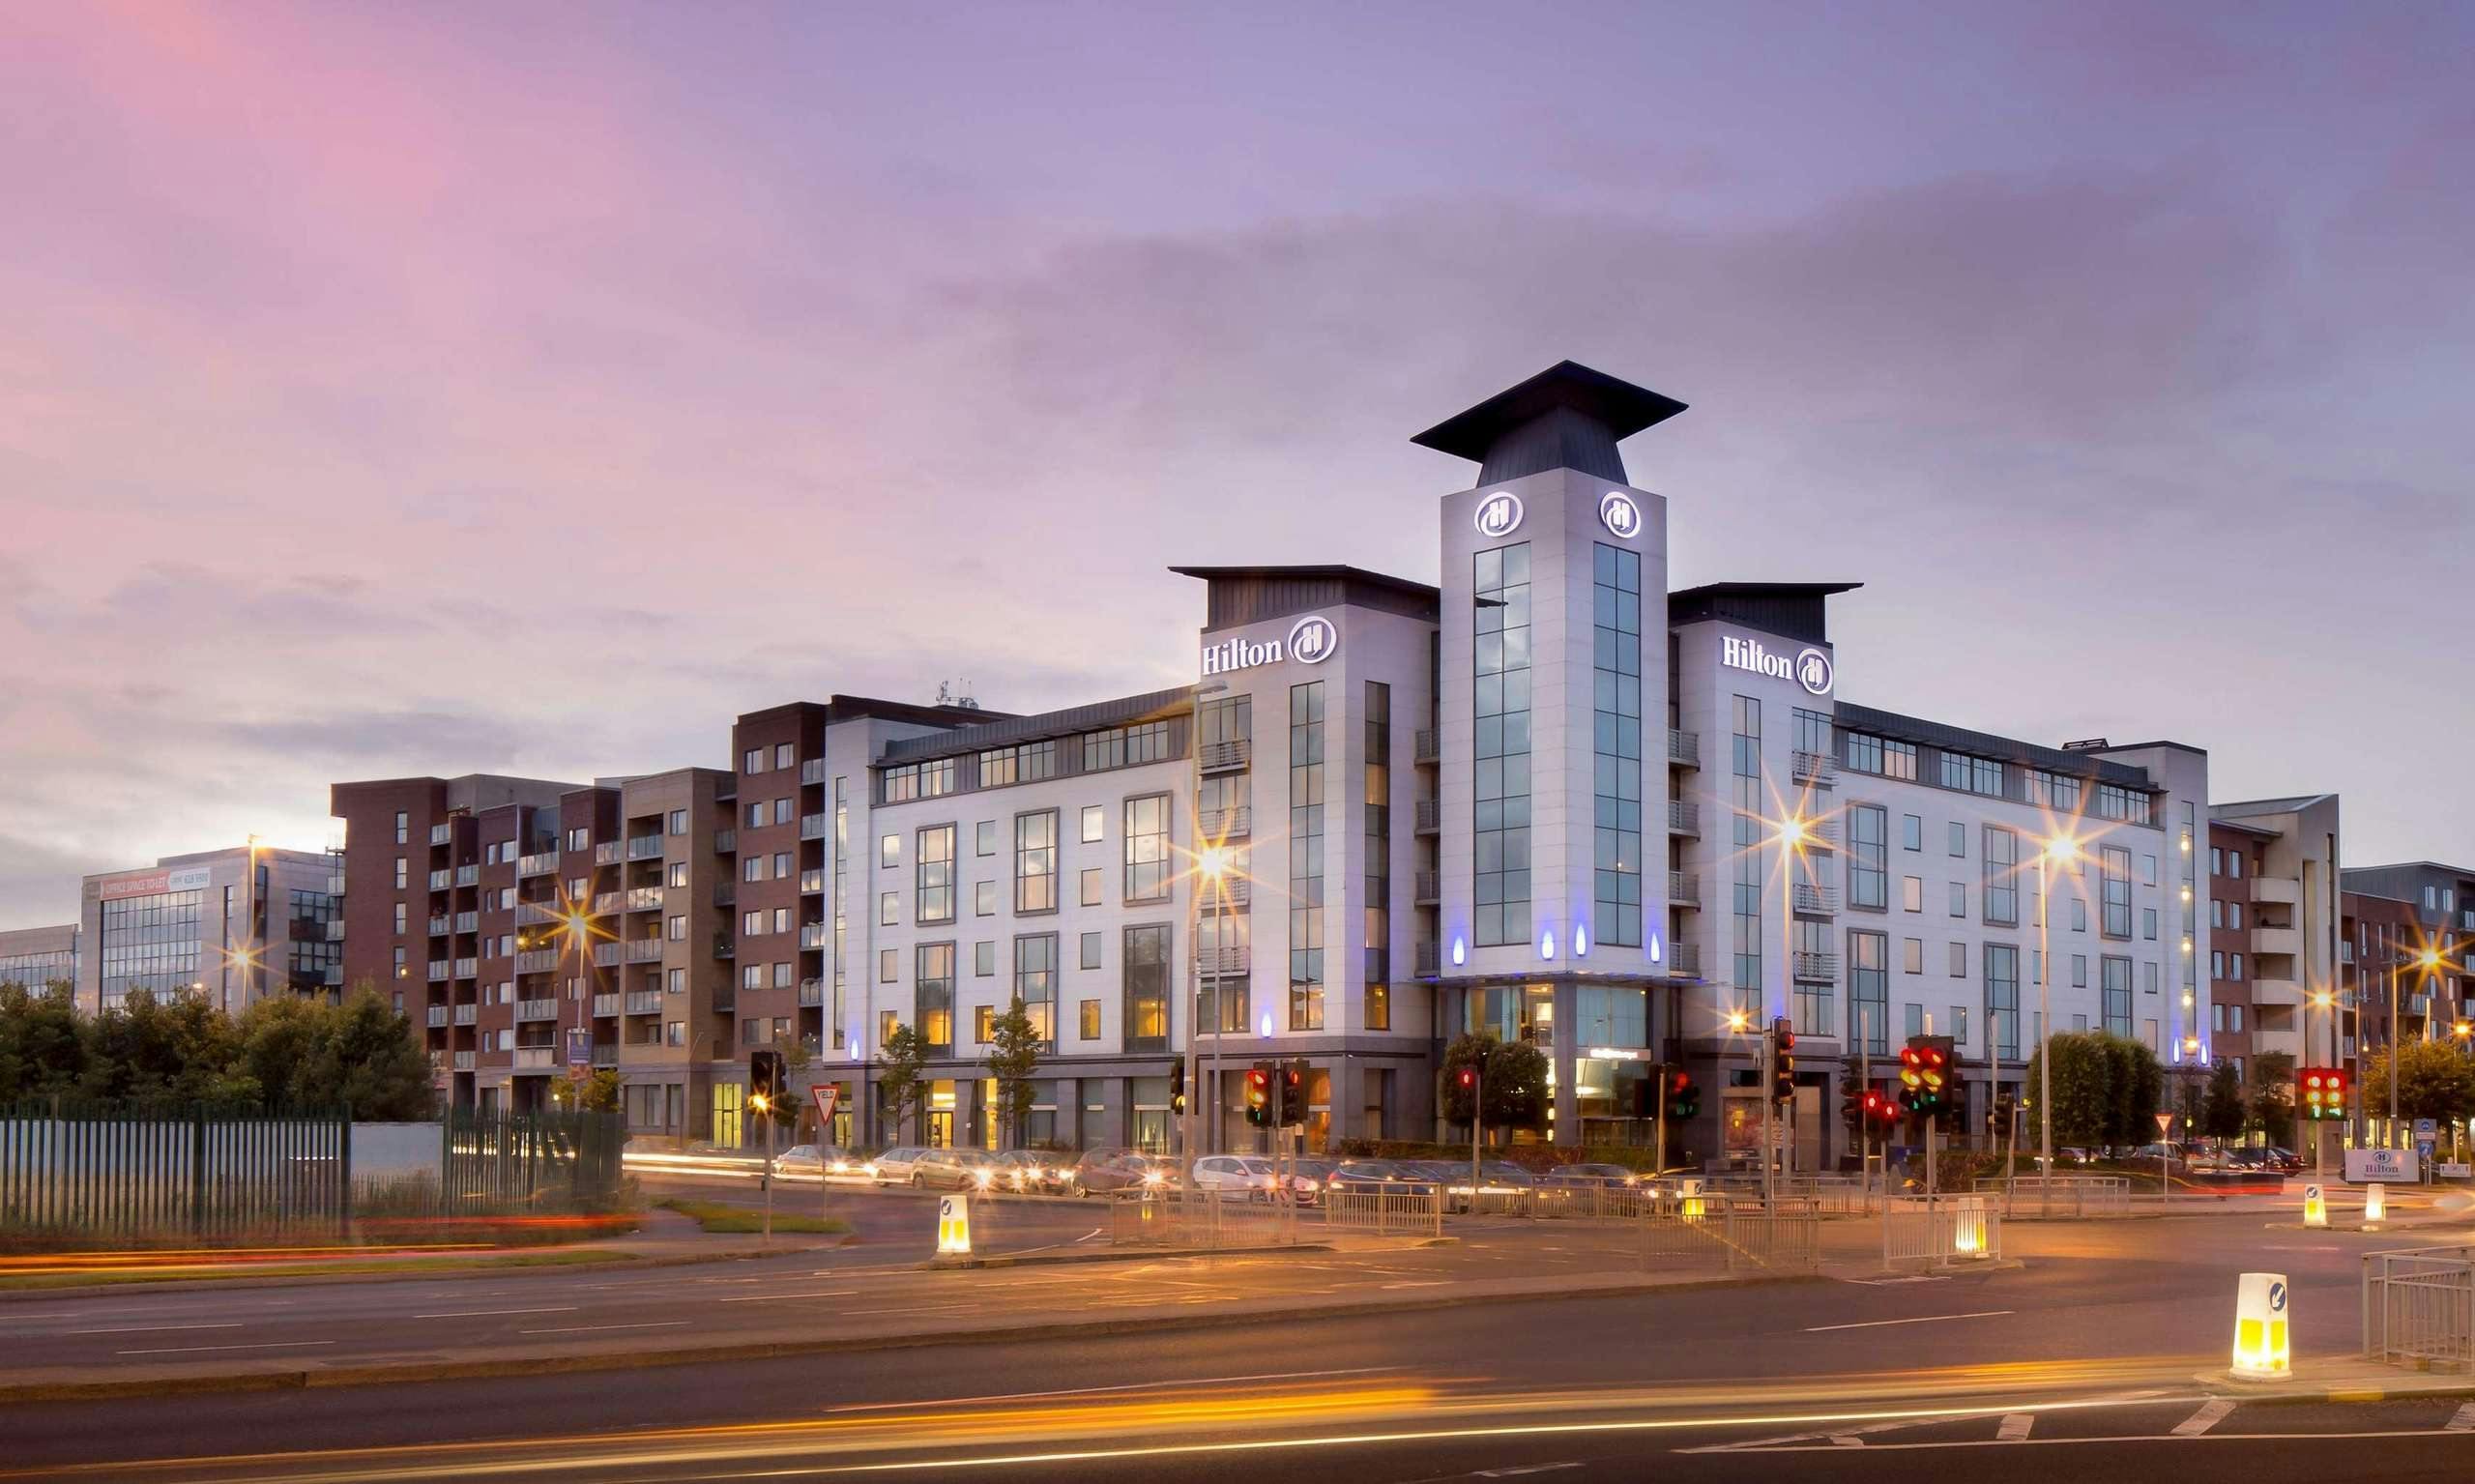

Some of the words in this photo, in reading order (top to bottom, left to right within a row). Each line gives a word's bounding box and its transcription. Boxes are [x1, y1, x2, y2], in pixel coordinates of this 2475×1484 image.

[1202, 638, 1284, 676] Hilton
[1723, 636, 1793, 680] Hilton
[817, 1090, 834, 1098] YIELD
[2366, 1164, 2399, 1173] Hilton
